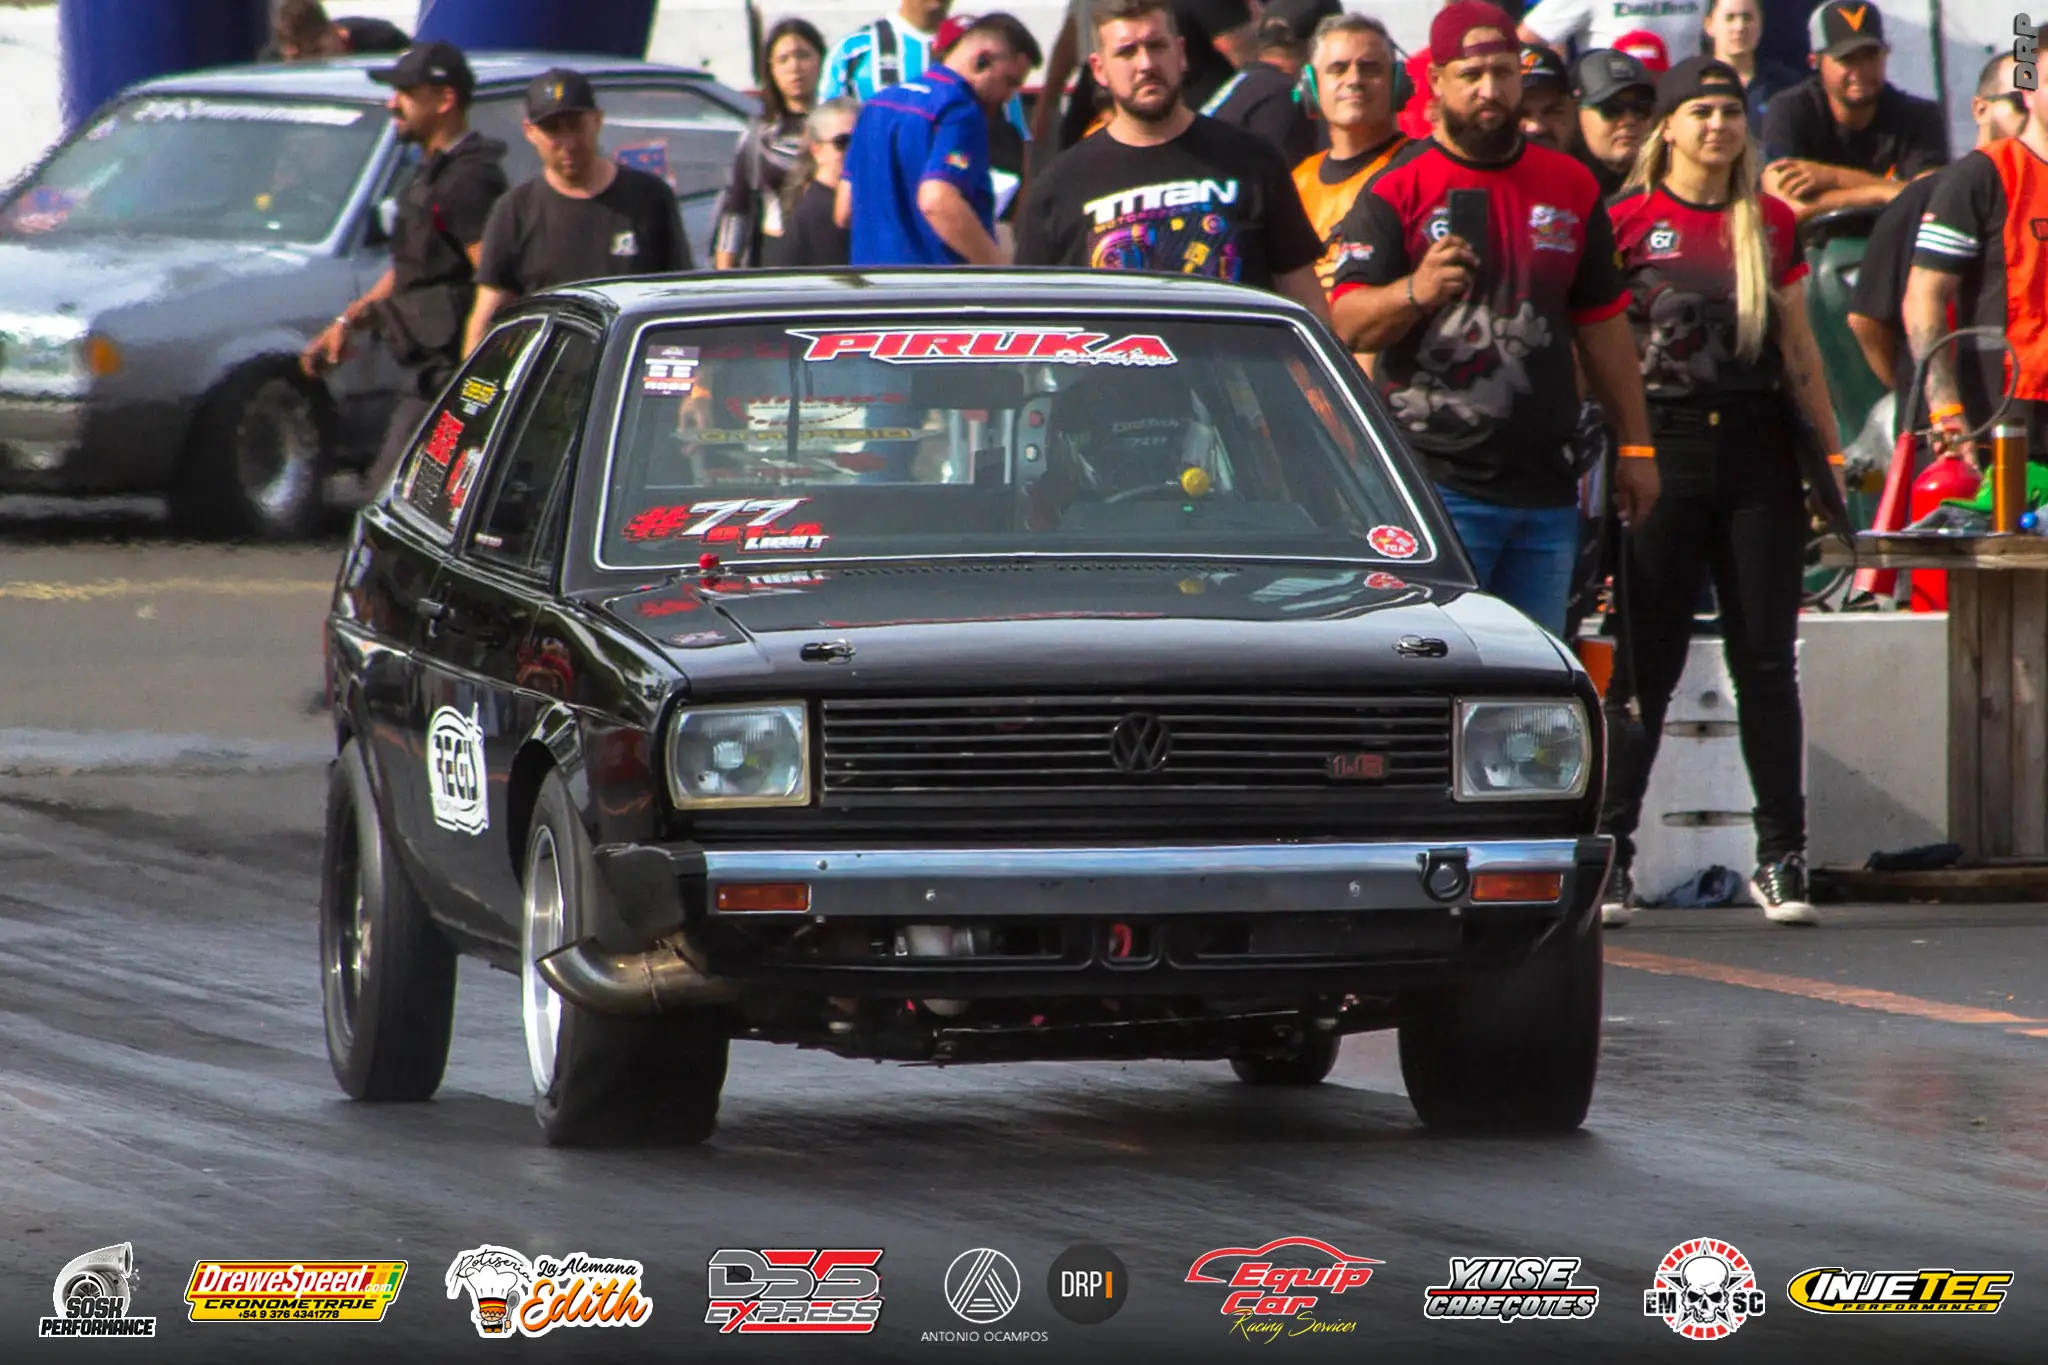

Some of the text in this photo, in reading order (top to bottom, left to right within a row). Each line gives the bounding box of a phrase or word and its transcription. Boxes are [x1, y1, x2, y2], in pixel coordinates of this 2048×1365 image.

[1650, 231, 1674, 249] 67
[802, 332, 1178, 362] PIRUKA
[622, 498, 813, 542] #77
